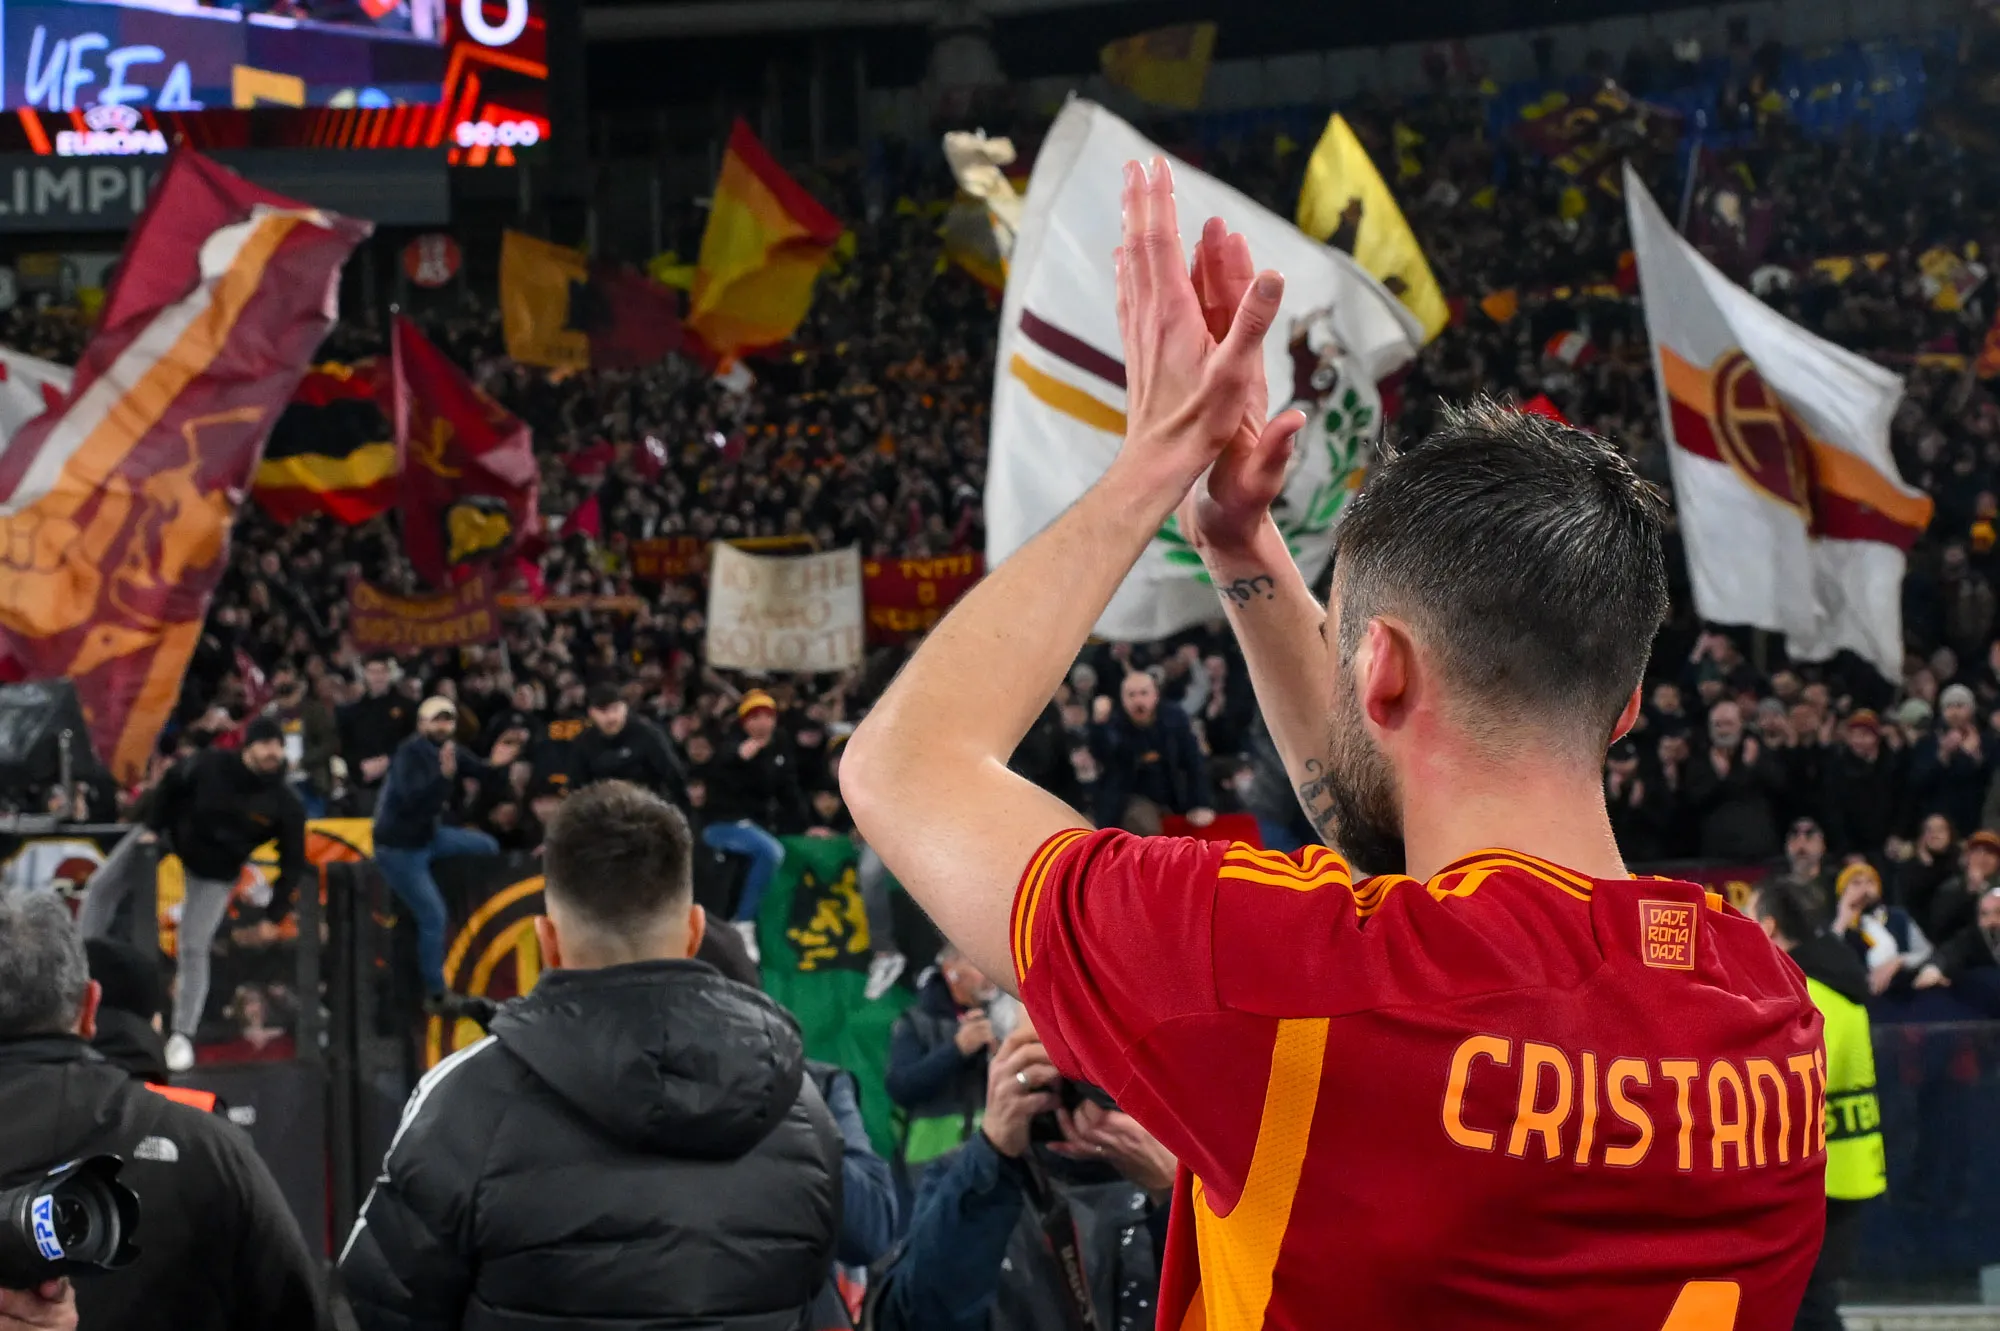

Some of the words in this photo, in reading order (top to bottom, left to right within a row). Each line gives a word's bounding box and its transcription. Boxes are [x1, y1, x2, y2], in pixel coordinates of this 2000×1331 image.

[25, 25, 204, 111] UEFA
[56, 130, 168, 156] EUROPA
[0, 166, 160, 215] IMPI
[1650, 908, 1688, 927] DAJE
[1648, 925, 1689, 943] ROMA
[1650, 943, 1685, 961] DAJE
[34, 1199, 62, 1258] FPA
